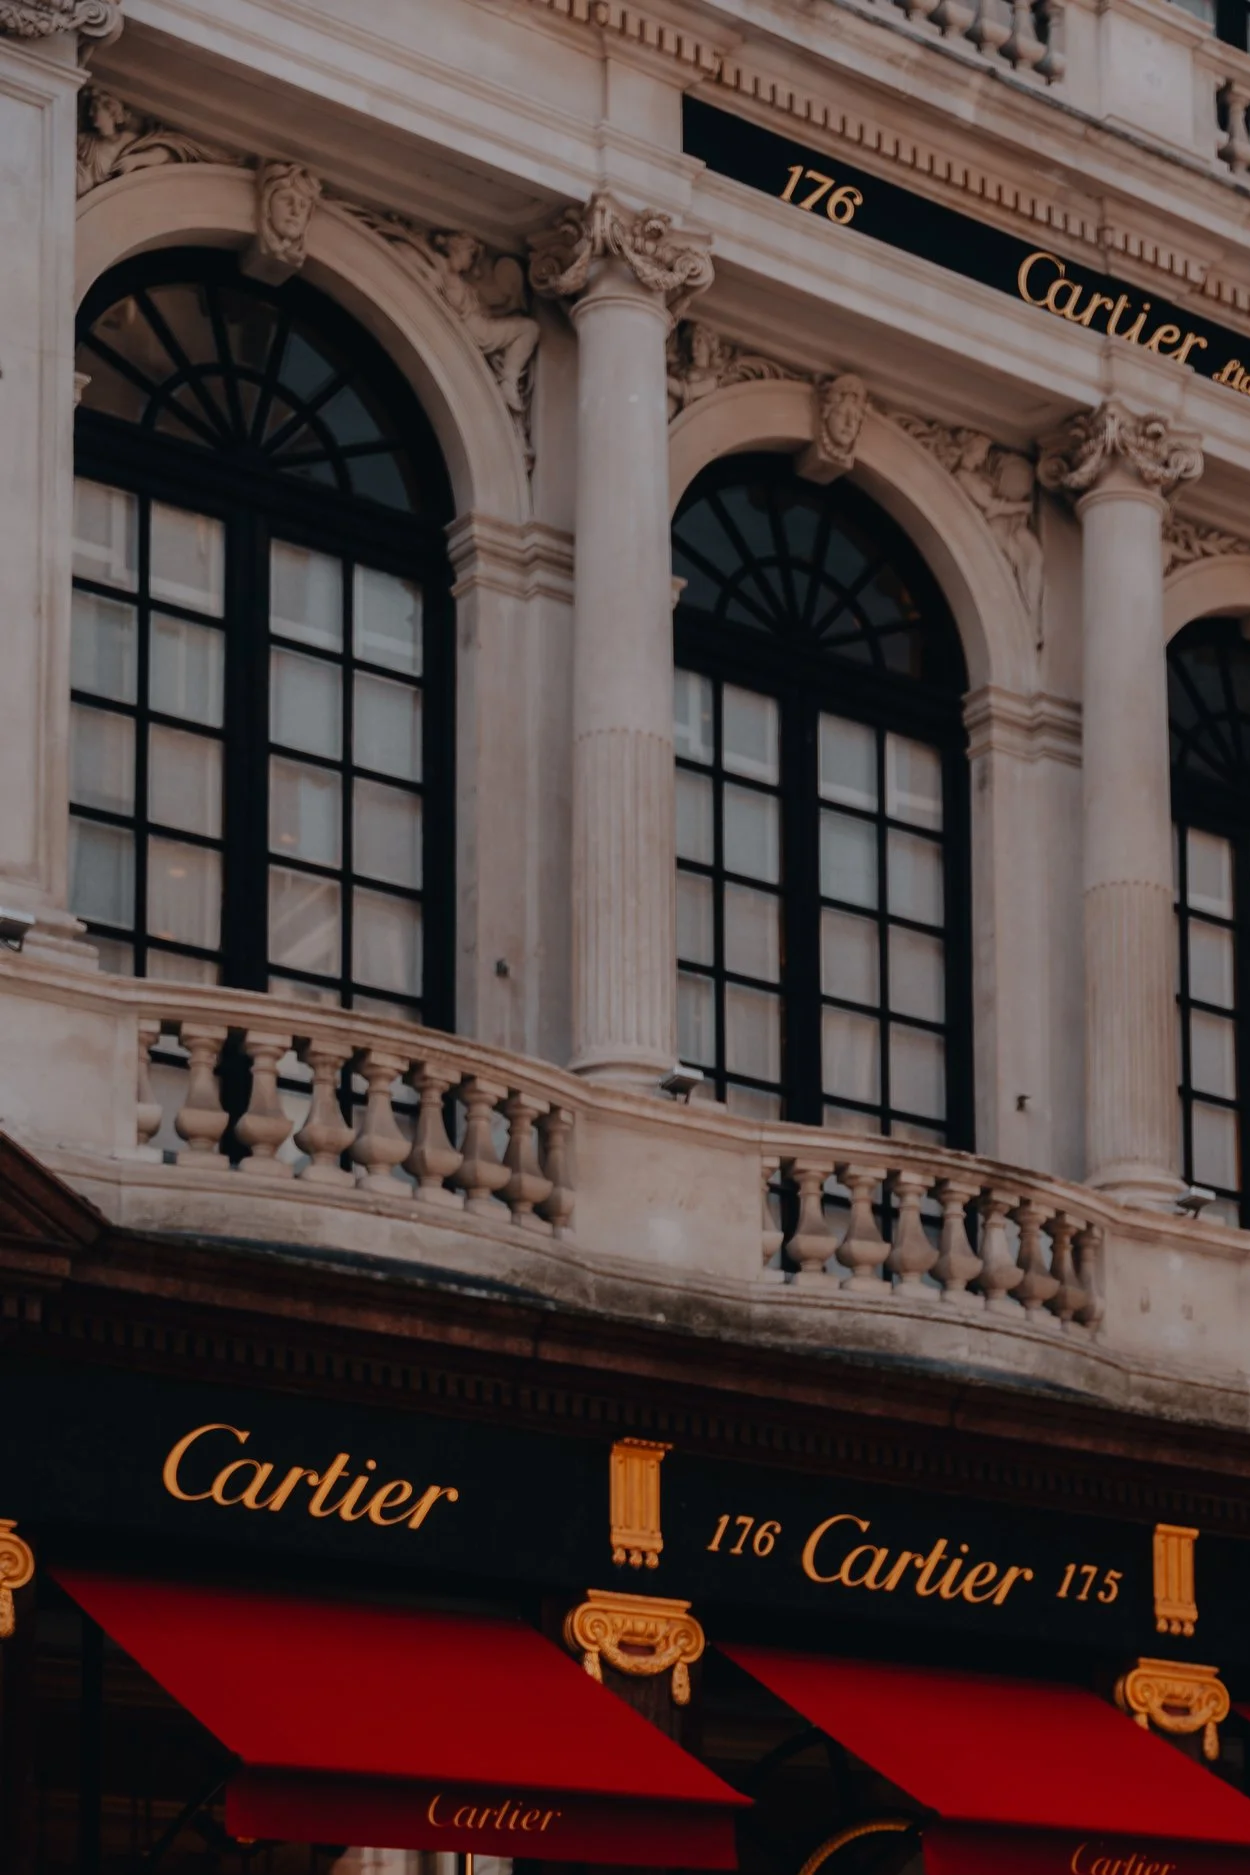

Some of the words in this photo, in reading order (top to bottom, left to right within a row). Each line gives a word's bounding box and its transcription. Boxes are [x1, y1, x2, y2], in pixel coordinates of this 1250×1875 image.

[781, 164, 863, 226] 176
[1016, 251, 1208, 365] Cartier
[162, 1423, 459, 1529] Cartier
[706, 1514, 782, 1557] 176
[801, 1514, 1034, 1605] Cartier
[1056, 1562, 1124, 1603] 175
[428, 1793, 562, 1833] Cartier
